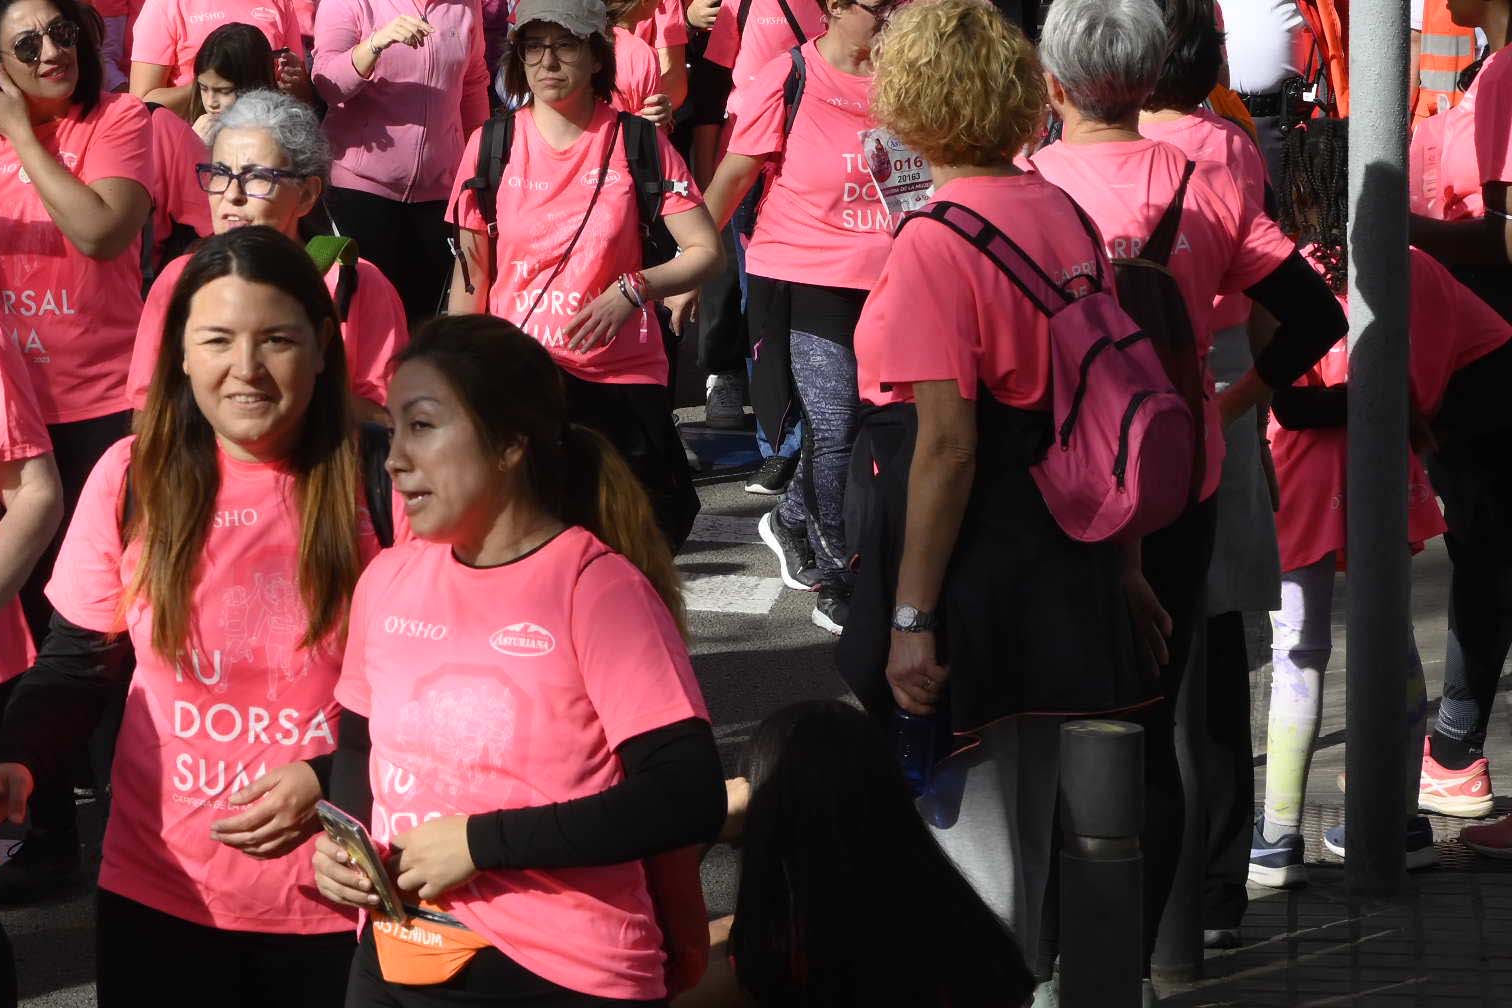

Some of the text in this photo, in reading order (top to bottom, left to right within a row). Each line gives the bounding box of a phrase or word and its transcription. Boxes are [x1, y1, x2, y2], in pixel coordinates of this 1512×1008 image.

[893, 156, 923, 172] 016
[897, 172, 921, 184] 20163
[843, 182, 880, 202] DO
[384, 615, 446, 641] OYSHO
[173, 700, 335, 746] DORSA
[172, 752, 272, 797] SUM
